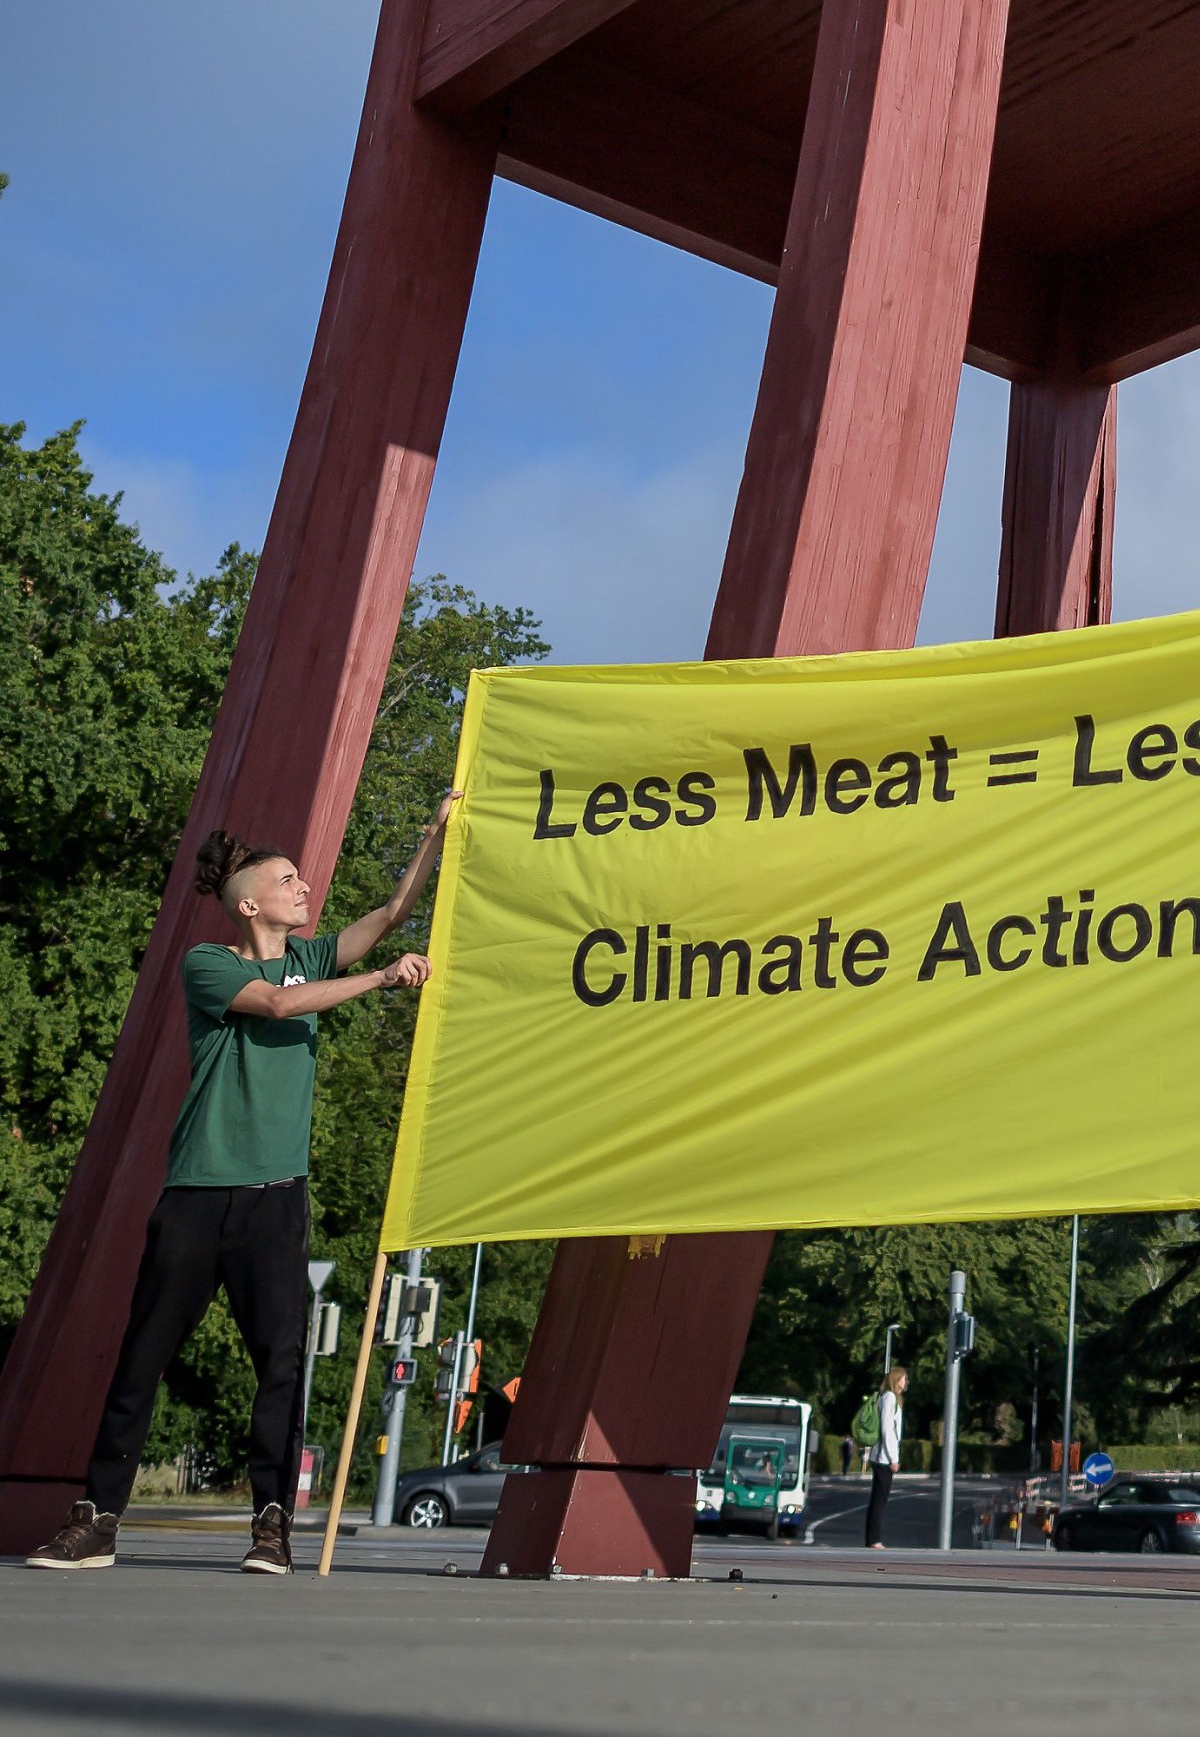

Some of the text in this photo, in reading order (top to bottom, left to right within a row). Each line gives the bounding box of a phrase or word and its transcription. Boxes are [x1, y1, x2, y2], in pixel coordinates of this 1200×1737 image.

[533, 769, 716, 839] Less
[743, 735, 957, 821] Meat
[988, 750, 1039, 787] =
[573, 917, 889, 1007] Climate
